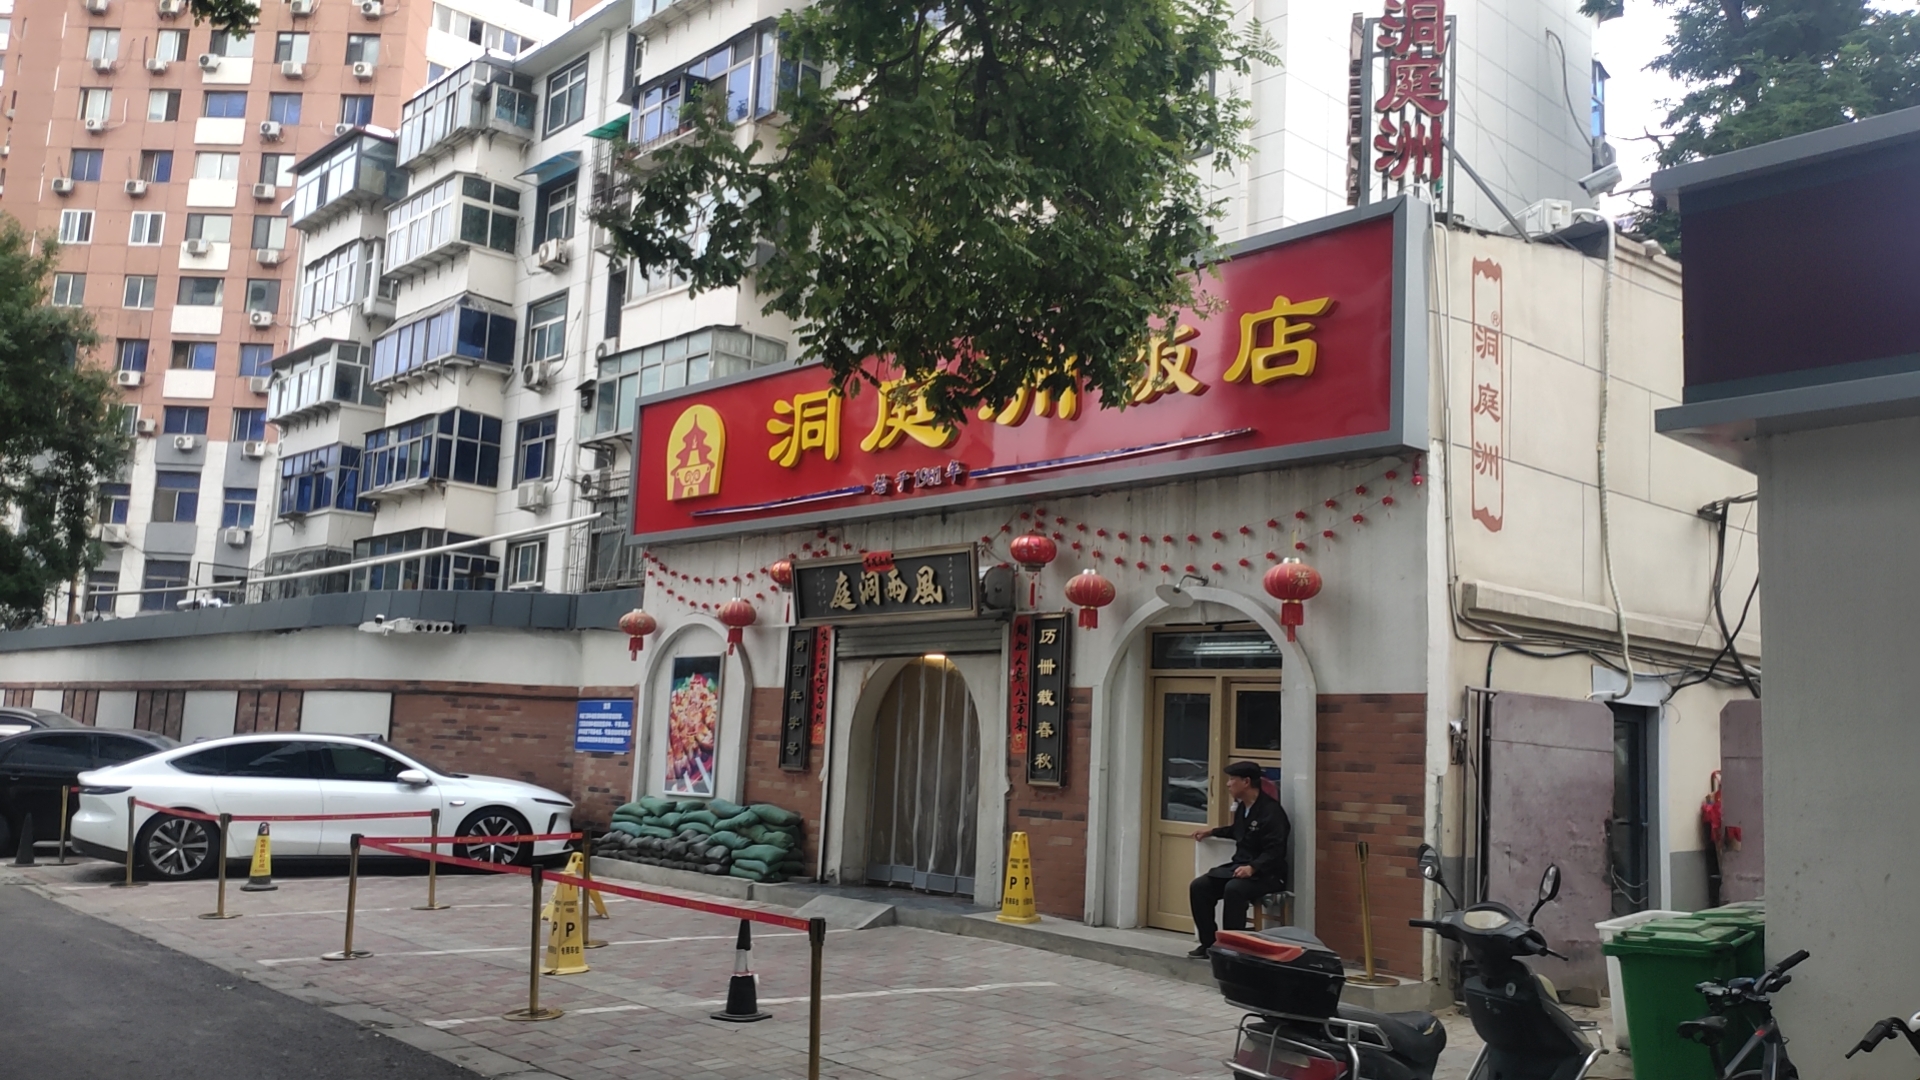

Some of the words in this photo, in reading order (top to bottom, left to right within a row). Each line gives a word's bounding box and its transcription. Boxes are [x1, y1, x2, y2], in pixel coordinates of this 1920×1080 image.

[1374, 0, 1448, 181] 洞庭洲
[1473, 325, 1500, 481] 洞庭洲
[1009, 876, 1017, 890] P
[1024, 876, 1030, 890] P
[565, 922, 575, 938] P
